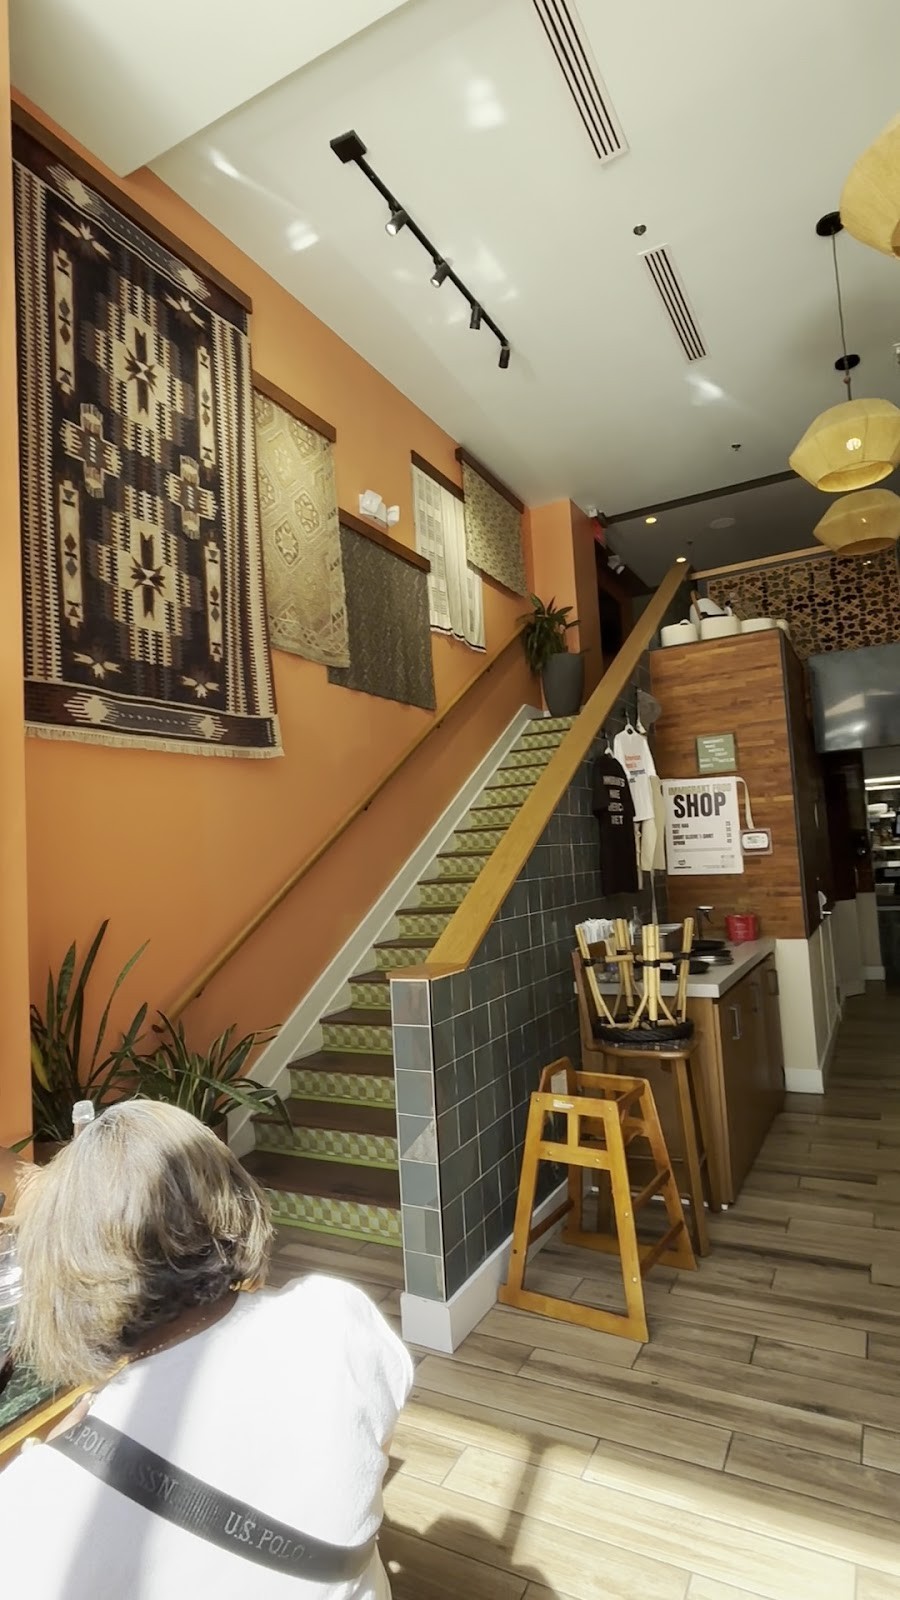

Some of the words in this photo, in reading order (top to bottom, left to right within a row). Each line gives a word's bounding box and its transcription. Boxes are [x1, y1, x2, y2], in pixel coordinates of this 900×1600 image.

[673, 792, 726, 818] SHOP
[224, 1511, 256, 1544] U.S.
[256, 1528, 306, 1561] POLO
